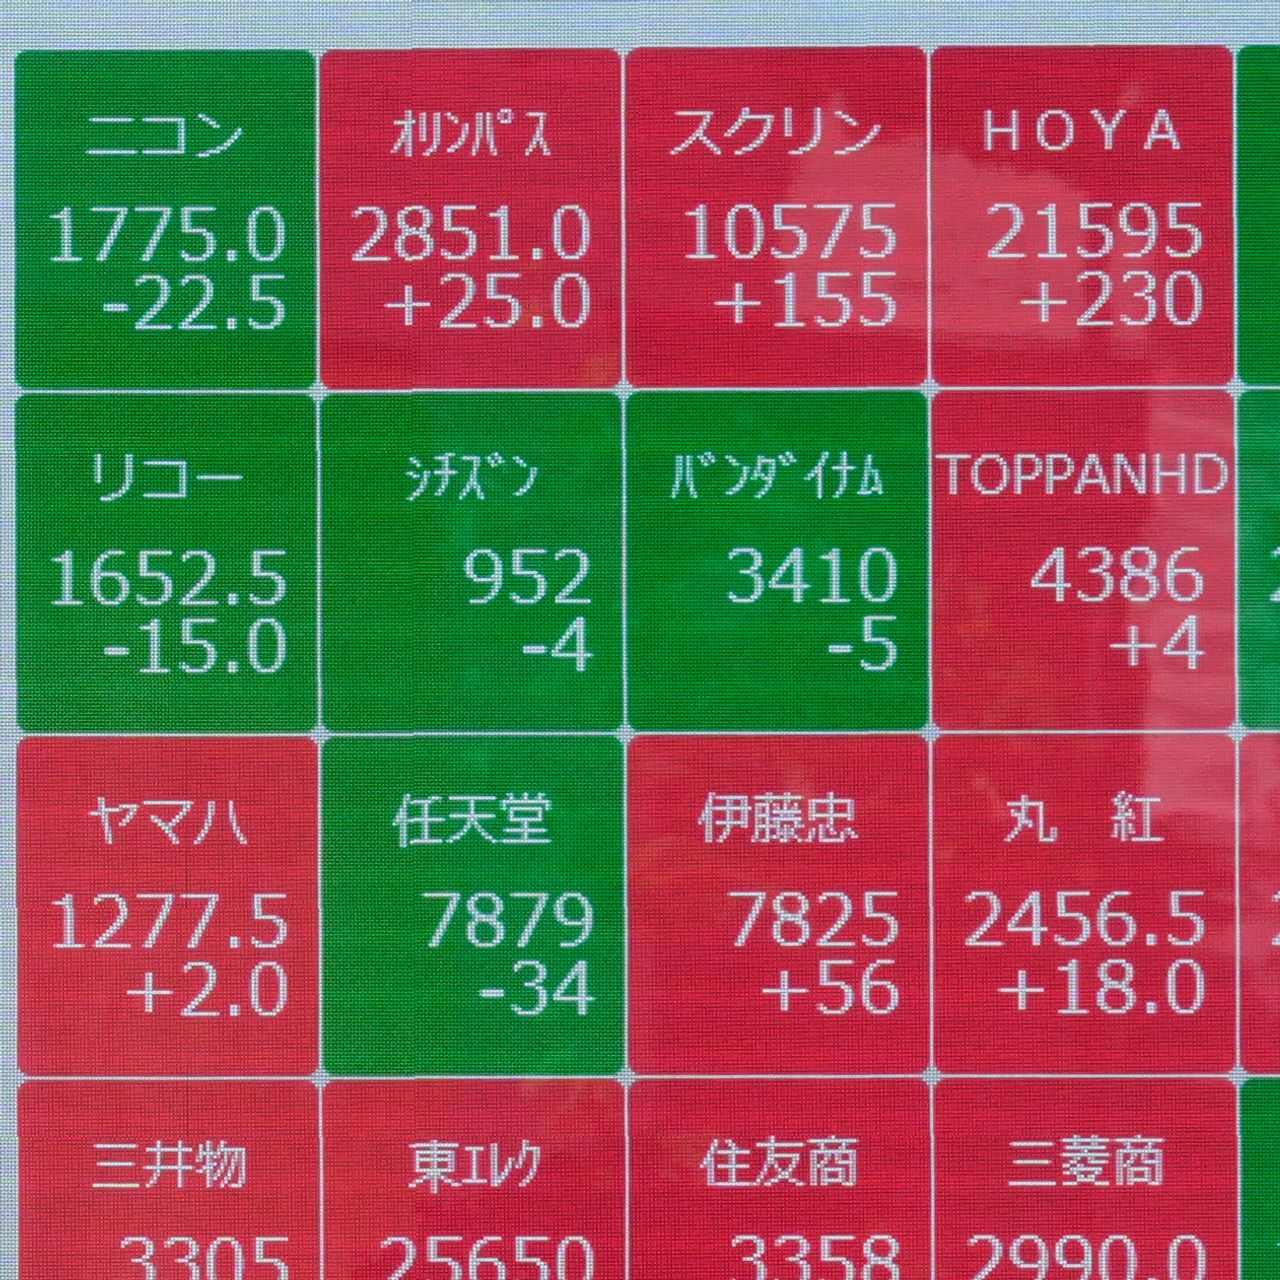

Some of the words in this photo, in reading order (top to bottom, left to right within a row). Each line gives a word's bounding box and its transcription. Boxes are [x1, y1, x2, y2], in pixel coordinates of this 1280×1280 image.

[87, 113, 243, 159] ニコン
[670, 107, 881, 157] スクリン
[52, 205, 285, 263] 1775.0
[352, 204, 591, 262] 2851.0
[687, 202, 896, 260] 10575
[988, 201, 1203, 259] 21595
[103, 273, 285, 331] -22.5
[386, 272, 591, 329] +25.0
[716, 270, 897, 328] +155
[1022, 269, 1203, 328] +230
[94, 453, 242, 503] リコー
[936, 452, 1229, 496] TOPPANHD
[53, 549, 286, 606] 1652.5
[464, 547, 590, 605] 952
[728, 546, 897, 604] 3410
[1030, 545, 1204, 604] 4386
[104, 617, 287, 674] -15.0
[1110, 614, 1204, 670] +4
[89, 796, 248, 845] ヤマハ
[393, 792, 551, 848] 任天堂
[698, 791, 858, 844] 伊藤忠
[54, 893, 288, 949] 1277.5
[423, 891, 594, 948] 7879
[729, 890, 899, 948] 7825
[965, 890, 1206, 947] 2456.5
[127, 960, 288, 1017] +2.0
[480, 959, 593, 1016] -34
[762, 958, 900, 1015] +56
[999, 958, 1206, 1015] +18.0
[93, 1140, 247, 1189] 三井物
[700, 1135, 858, 1188] 住友商
[1009, 1134, 1164, 1187] 三菱商
